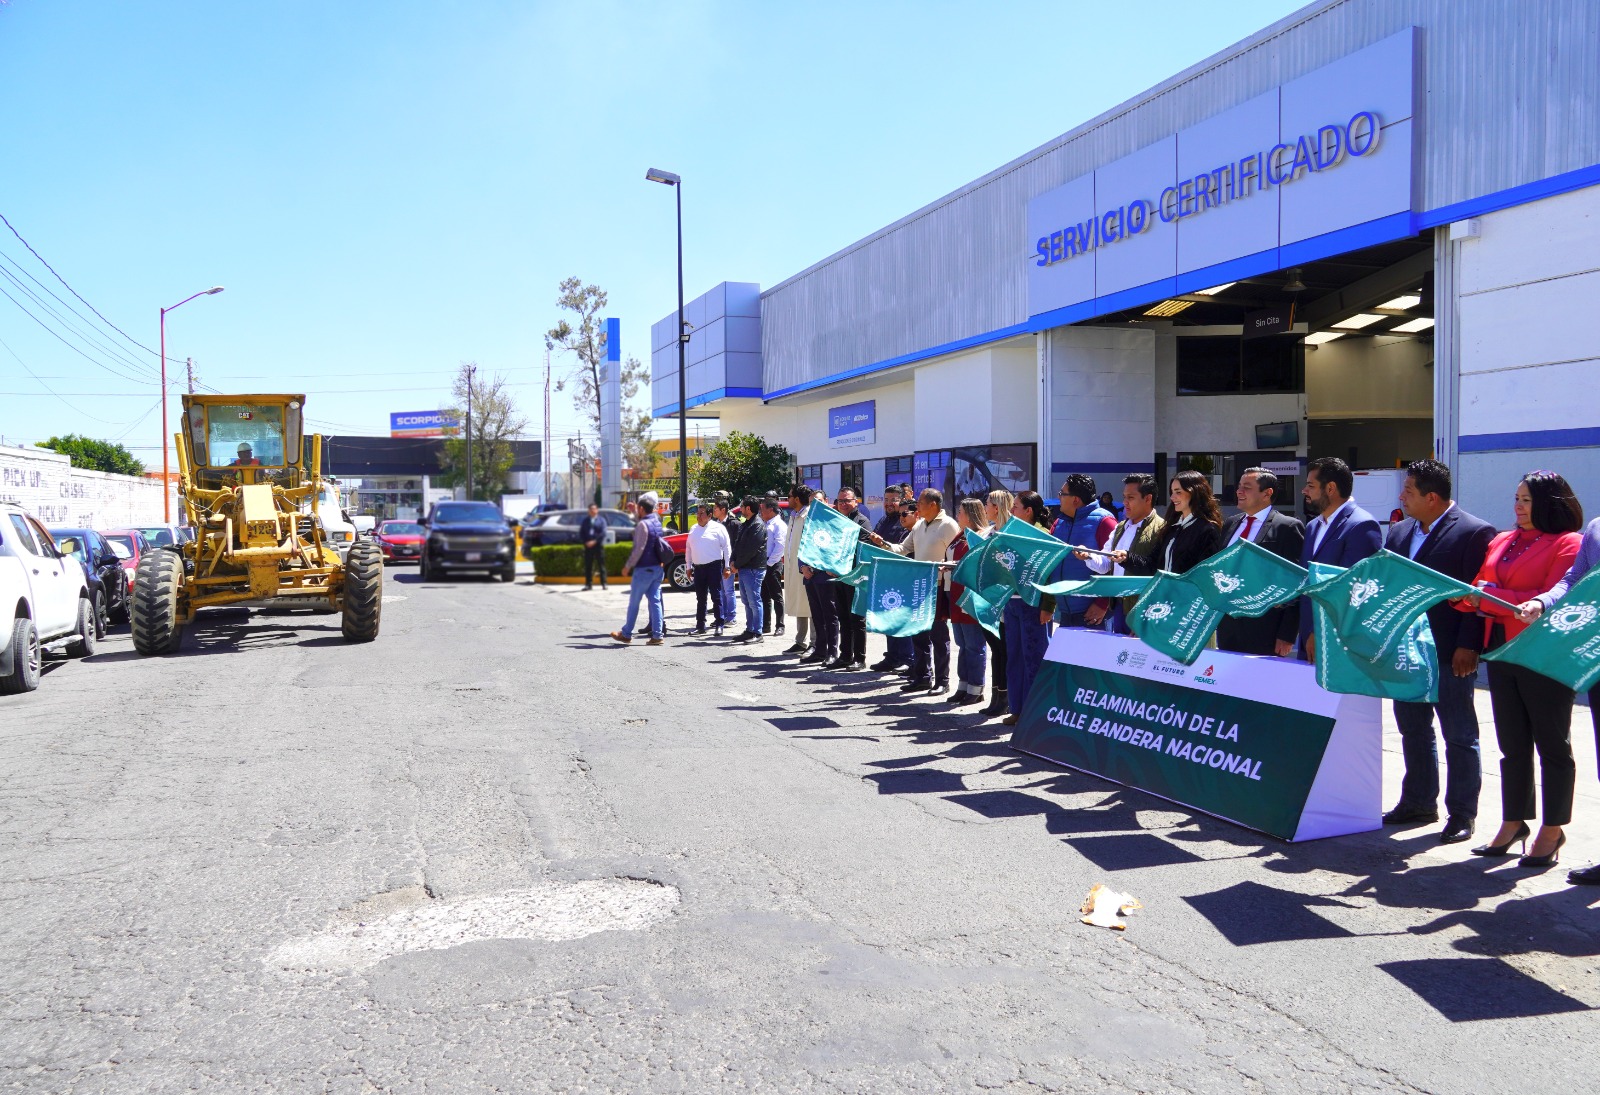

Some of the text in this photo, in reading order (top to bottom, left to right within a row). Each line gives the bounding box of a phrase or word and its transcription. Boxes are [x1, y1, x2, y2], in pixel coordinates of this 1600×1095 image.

[1036, 111, 1381, 267] SERVICIO CERTIFICADO
[1255, 316, 1280, 328] Sin Cita
[3, 468, 41, 488] PICK UP
[38, 504, 56, 522] PICK
[58, 504, 68, 522] UP
[1018, 568, 1029, 585] San
[910, 579, 920, 622] San Martín
[1243, 584, 1278, 603] Martín
[1361, 584, 1425, 628] San Martín
[1168, 628, 1184, 646] San
[1179, 596, 1204, 629] Martín
[1369, 587, 1437, 635] Texmelucan
[1176, 604, 1210, 652] Texmeluca
[1394, 643, 1408, 671] San
[1573, 635, 1600, 655] San
[1161, 666, 1186, 676] FUTURO
[1194, 676, 1216, 685] PEMEX
[1073, 687, 1239, 743] RELAMINACIÓN DE LA
[1047, 706, 1262, 781] CALLE BANDERA NACIONAL
